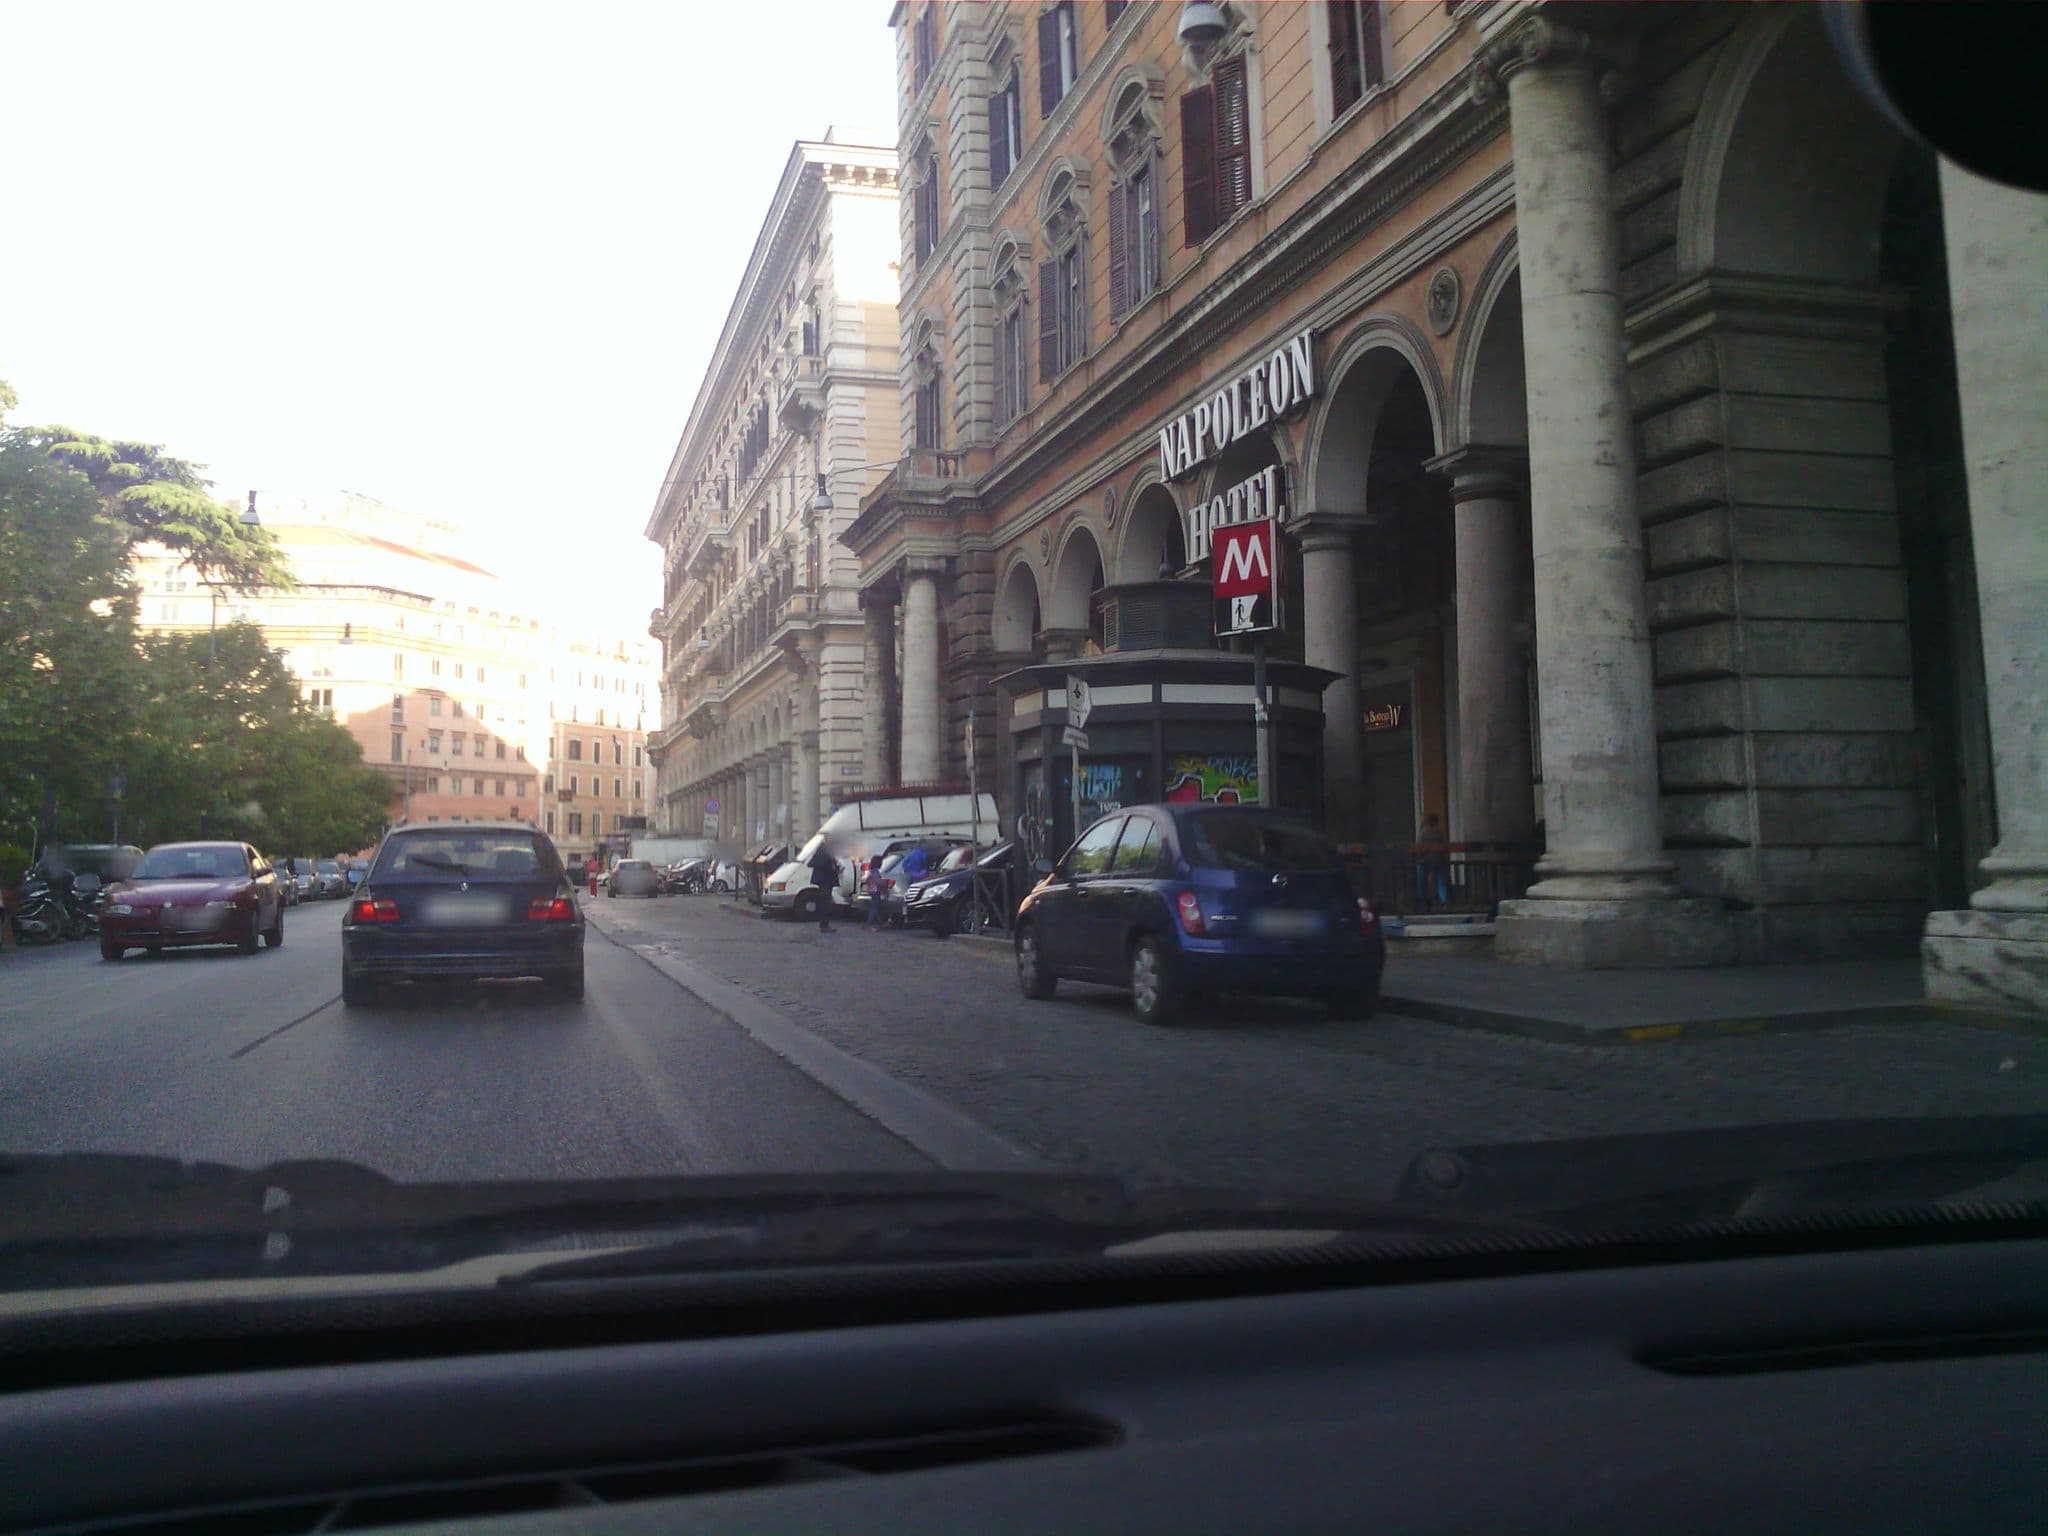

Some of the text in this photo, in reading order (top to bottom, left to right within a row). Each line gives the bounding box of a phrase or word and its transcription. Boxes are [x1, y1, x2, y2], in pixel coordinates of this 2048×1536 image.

[1159, 328, 1316, 483] NAPOLEON
[1187, 464, 1286, 564] HOTEL
[1220, 534, 1269, 583] M
